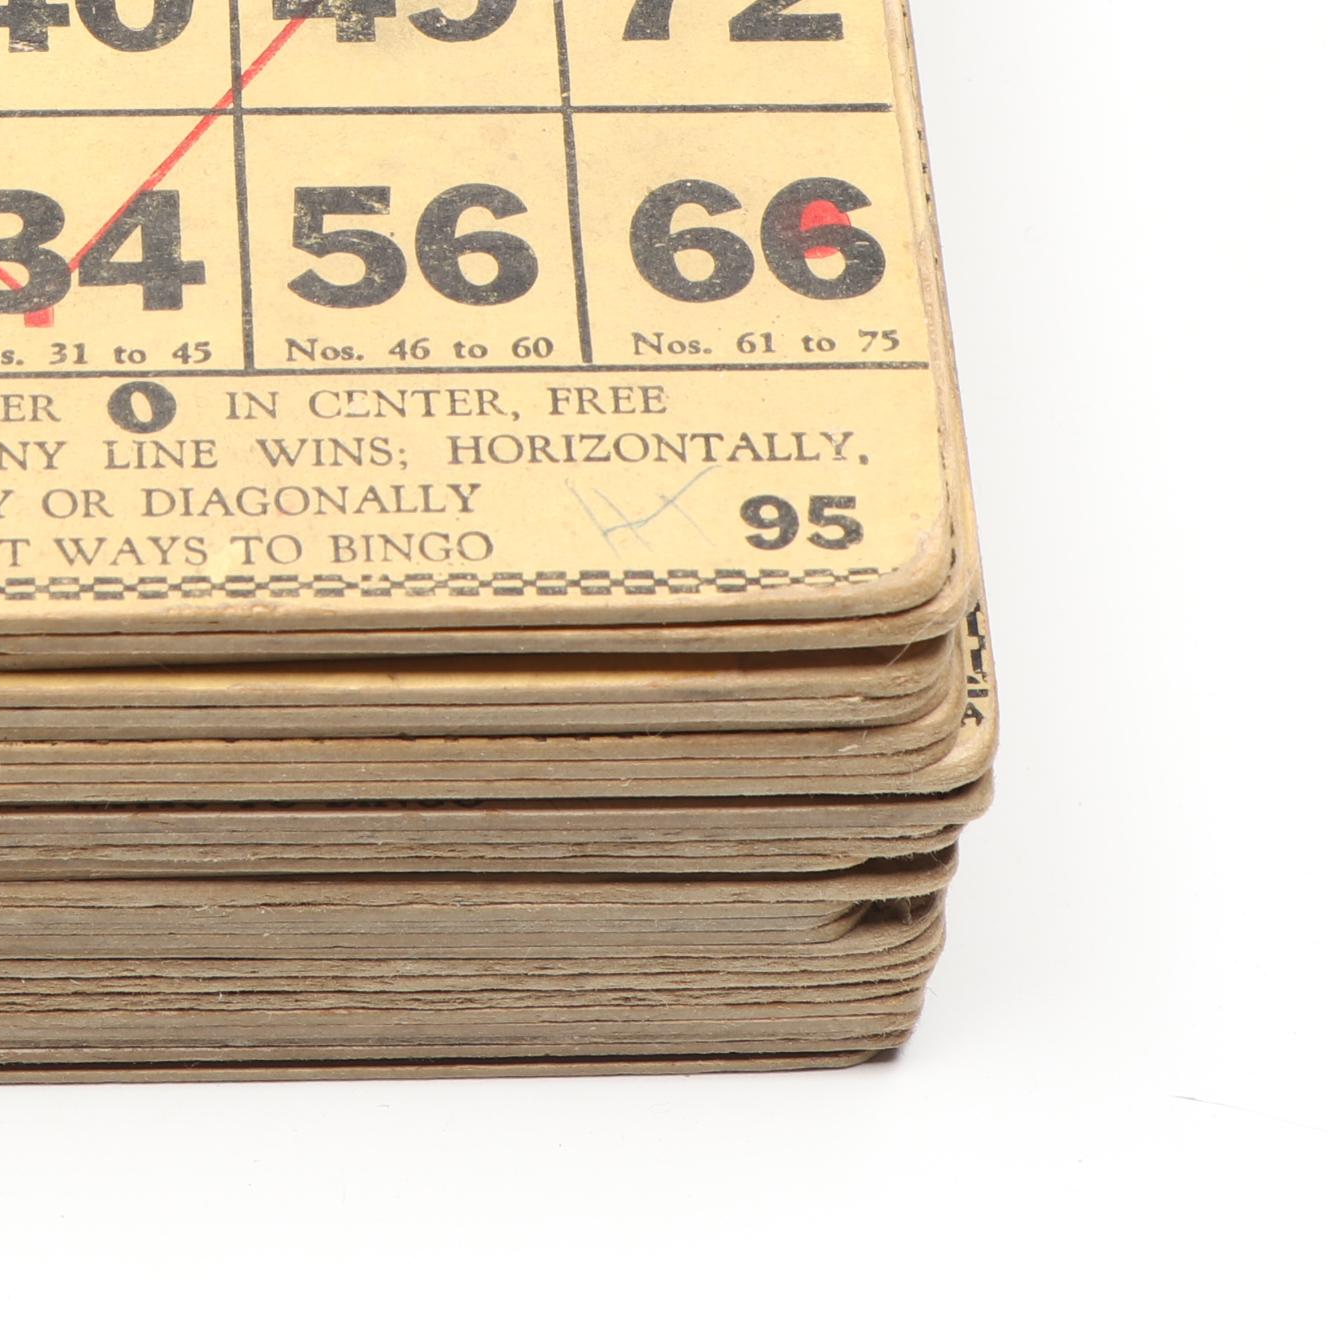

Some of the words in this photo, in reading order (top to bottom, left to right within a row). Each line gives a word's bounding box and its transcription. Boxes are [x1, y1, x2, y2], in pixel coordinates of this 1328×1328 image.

[287, 182, 539, 309] 56
[629, 176, 887, 304] 66
[49, 342, 88, 365] 31
[113, 345, 147, 365] to
[171, 340, 212, 365] 45
[285, 337, 365, 362] Nos.
[388, 337, 431, 361] 46
[452, 340, 489, 359] to
[511, 336, 554, 359] 60
[631, 331, 713, 356] Nos.
[736, 331, 776, 354] 61
[801, 334, 837, 353] to
[858, 329, 900, 353] 75
[225, 391, 279, 420] IN
[308, 388, 520, 422] CENTER,
[546, 385, 668, 416] FREE
[102, 439, 218, 470] LINE
[255, 436, 408, 471] WINS;
[41, 488, 114, 519] OR
[141, 482, 482, 518] DIAGONALLY
[739, 494, 864, 551] 95
[53, 535, 208, 567] WAYS
[229, 534, 303, 566] TO
[328, 530, 494, 564] BINGO
